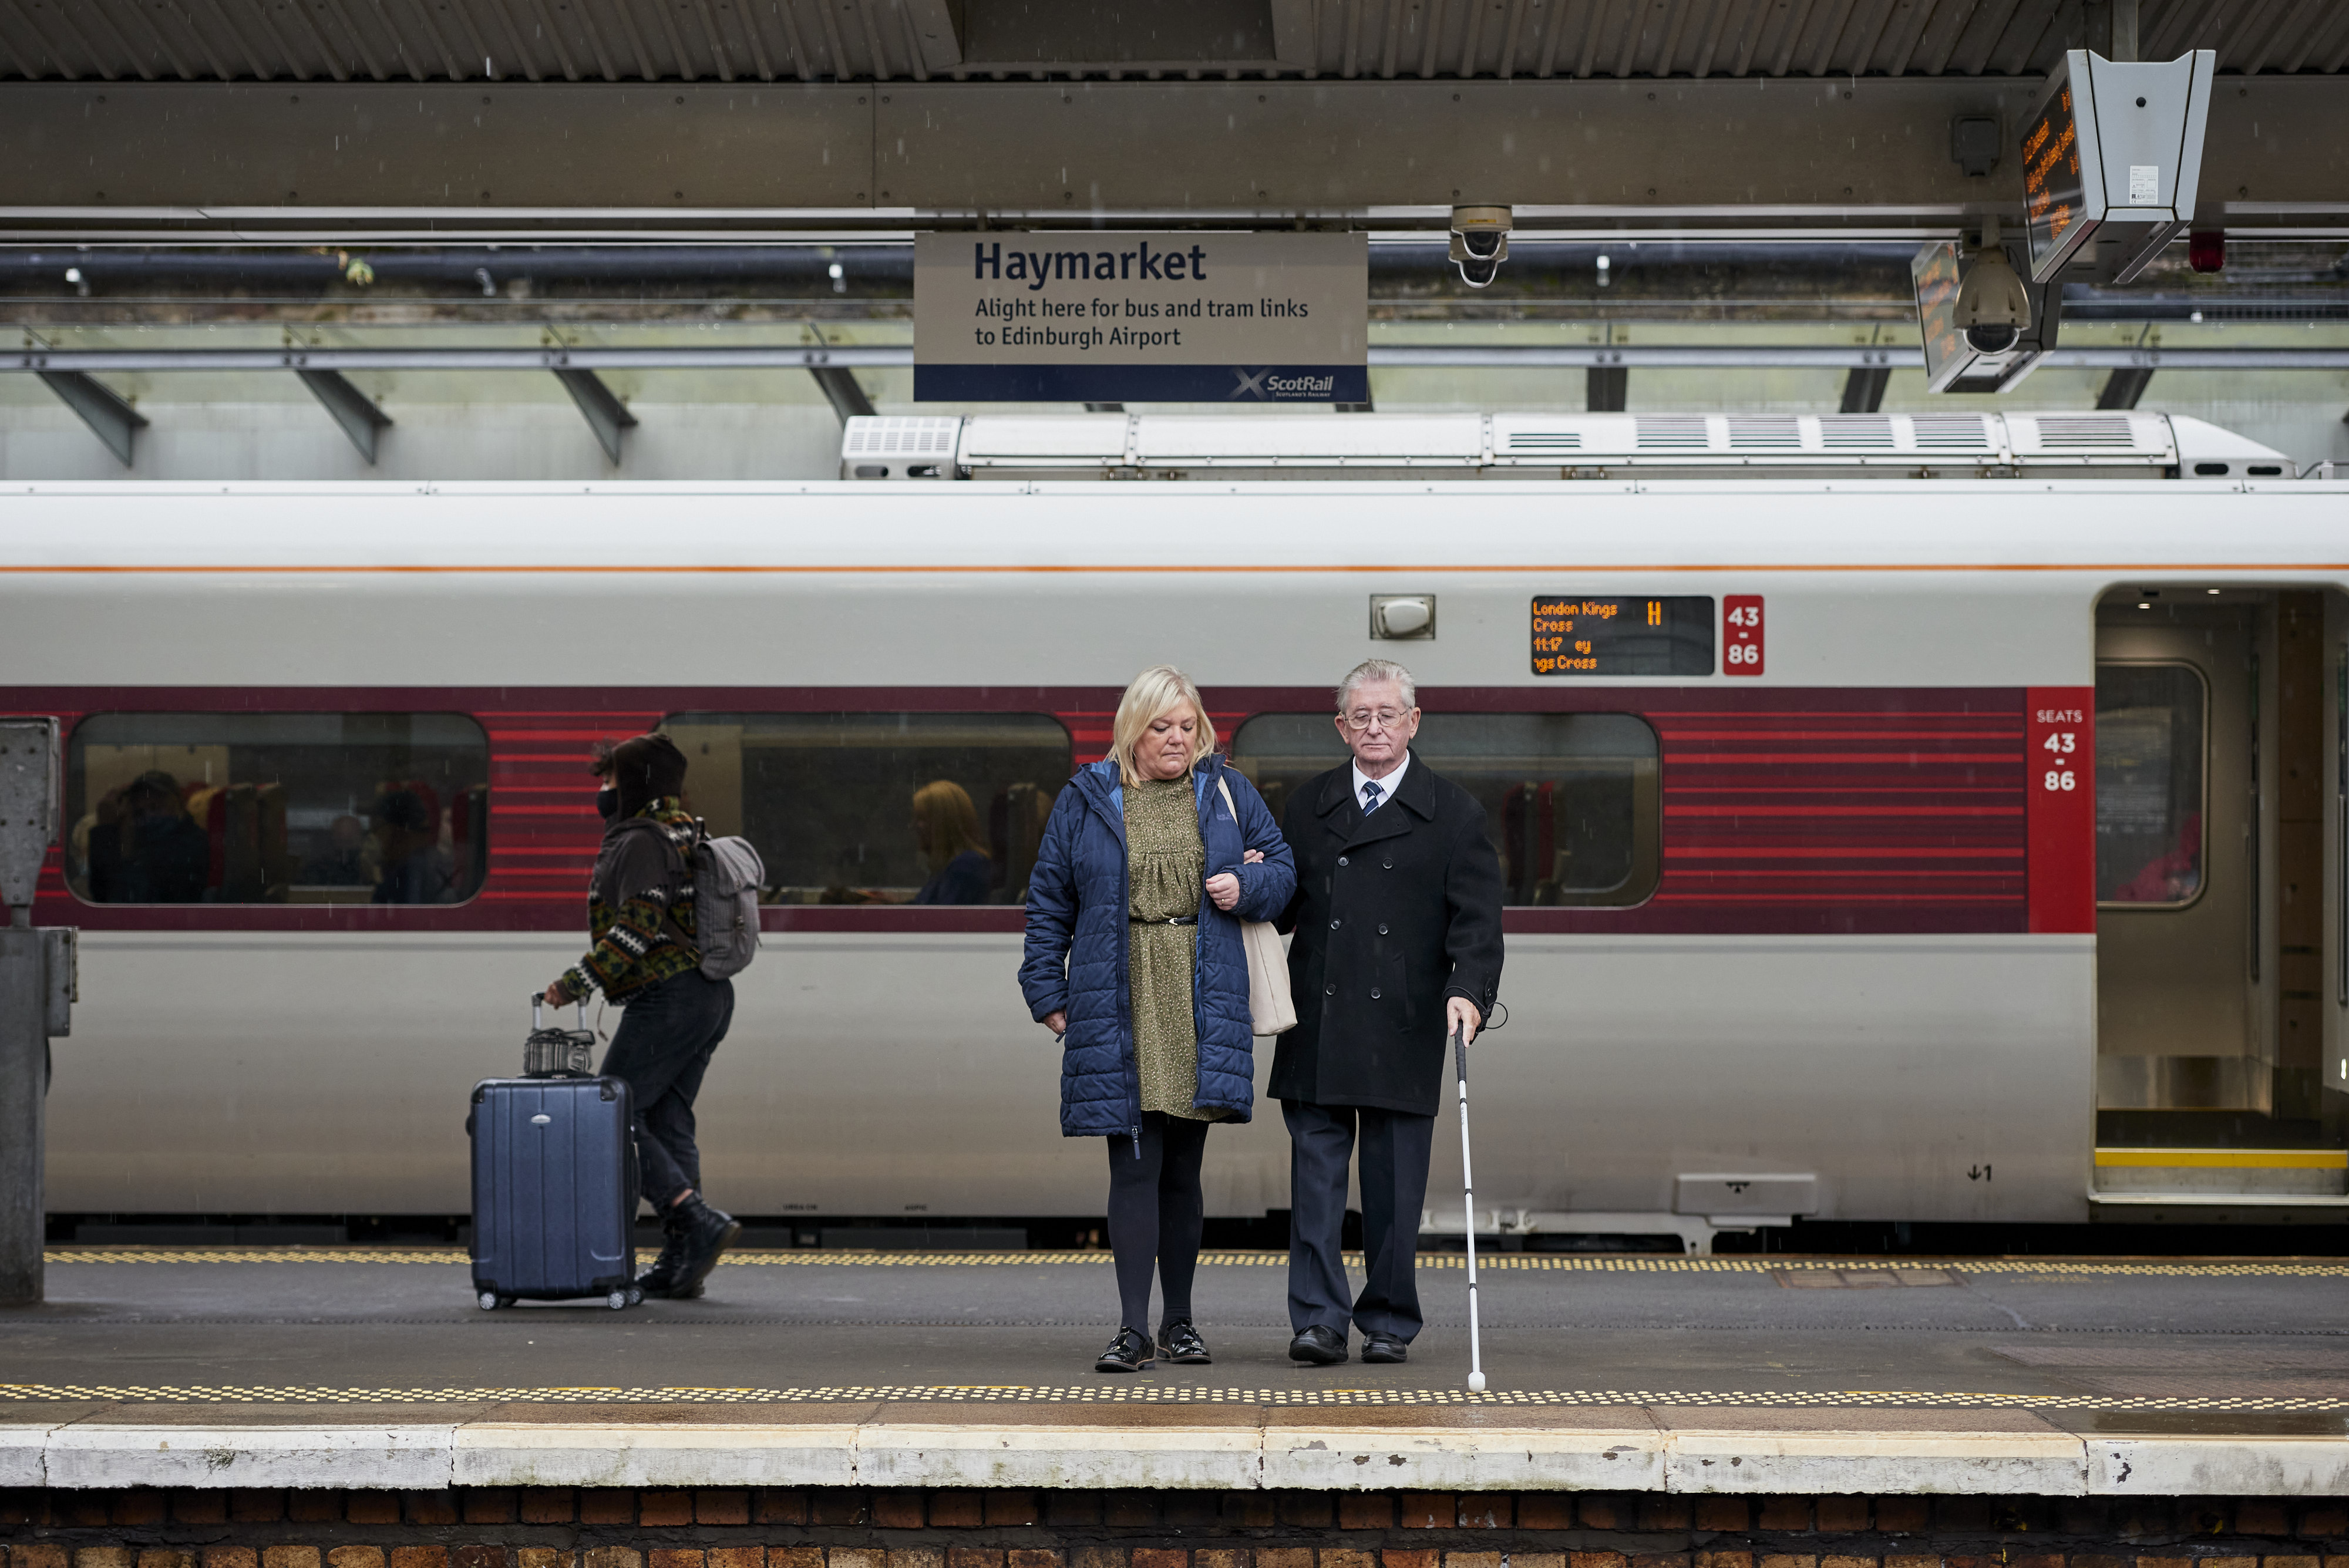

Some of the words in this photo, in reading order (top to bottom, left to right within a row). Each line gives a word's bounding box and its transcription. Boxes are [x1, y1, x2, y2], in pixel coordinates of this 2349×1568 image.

[975, 241, 1207, 290] Haymarket
[975, 298, 1036, 321] Alight
[1043, 298, 1086, 317] here
[1091, 298, 1119, 317] for
[1125, 298, 1159, 317] bus
[1165, 298, 1200, 317] and
[1207, 300, 1254, 317] tram
[1261, 298, 1308, 317] links
[975, 328, 995, 345] to
[1002, 326, 1102, 350] Edinburgh
[1109, 326, 1181, 350] Airport
[1267, 375, 1334, 391] ScotRail
[1533, 601, 1579, 615] London
[1582, 601, 1618, 619] Kings
[1647, 601, 1661, 625] H
[1728, 607, 1759, 626] 43
[1533, 618, 1573, 632] Cross
[1557, 655, 1597, 669] Cross
[1728, 644, 1759, 664] 86
[2037, 709, 2082, 723] SEATS
[2044, 733, 2075, 753] 43
[2044, 770, 2076, 791] 86
[1983, 1164, 1991, 1182] 1
